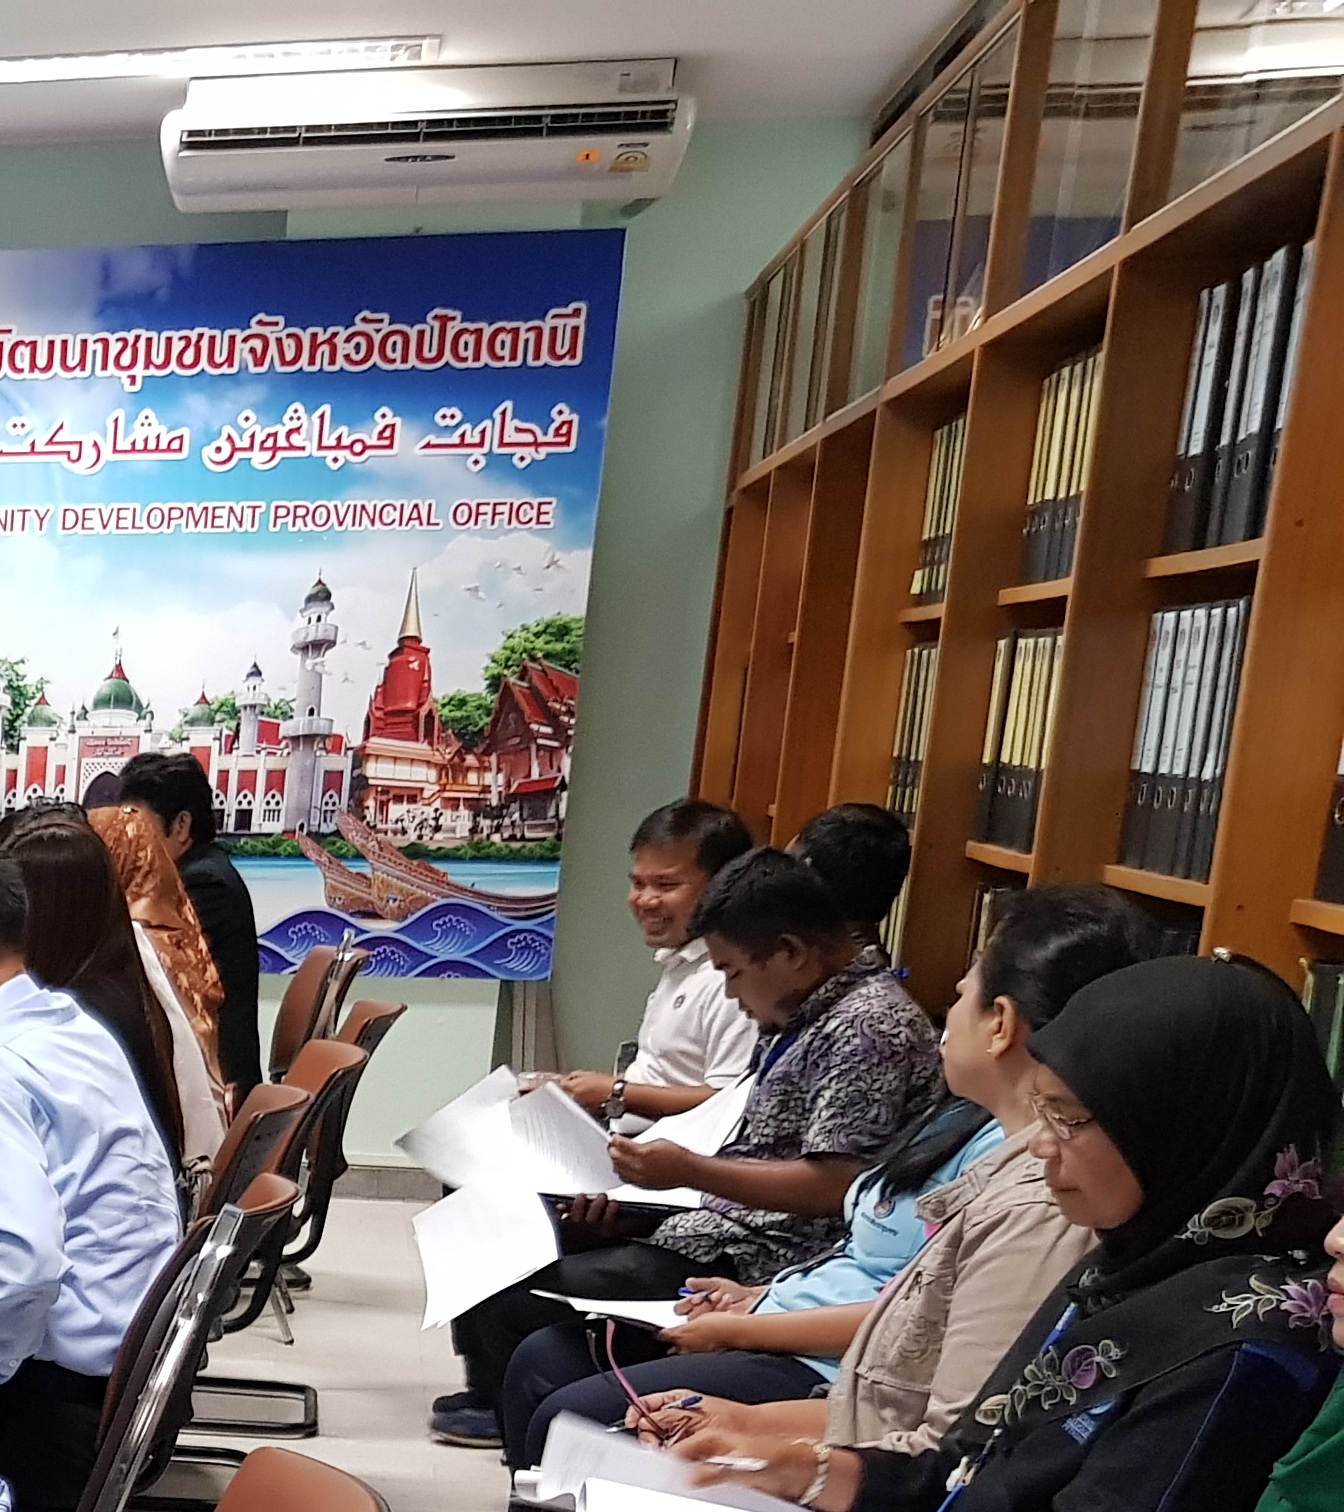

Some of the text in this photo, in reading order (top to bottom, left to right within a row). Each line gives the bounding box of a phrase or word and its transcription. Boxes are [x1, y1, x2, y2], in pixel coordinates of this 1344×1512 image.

[418, 404, 575, 468] فجابت
[61, 505, 263, 532] DEVELOPMENT
[269, 501, 441, 529] PROVINCIAL
[451, 500, 555, 527] OFFICE
